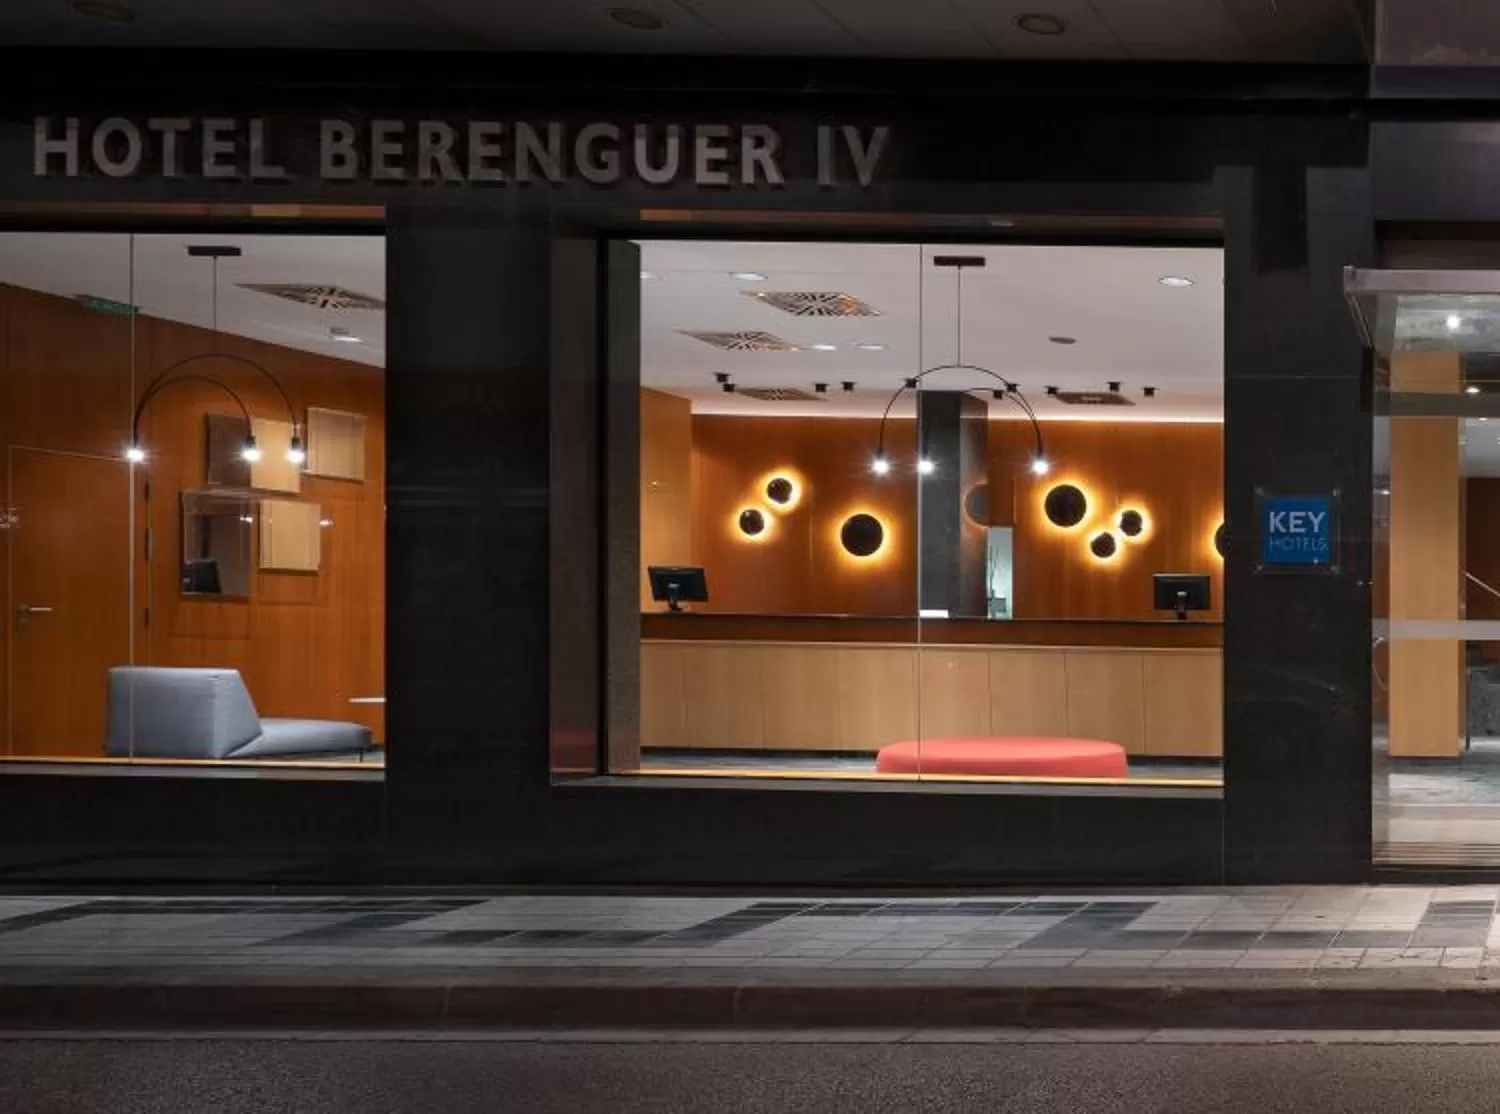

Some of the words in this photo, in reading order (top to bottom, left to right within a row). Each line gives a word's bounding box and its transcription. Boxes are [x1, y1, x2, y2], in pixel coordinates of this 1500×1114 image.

[33, 117, 285, 179] HOTEL
[320, 119, 785, 185] BERENGUER
[816, 125, 891, 186] IV
[1269, 511, 1326, 533] KEY
[1269, 536, 1329, 551] HOTELS
